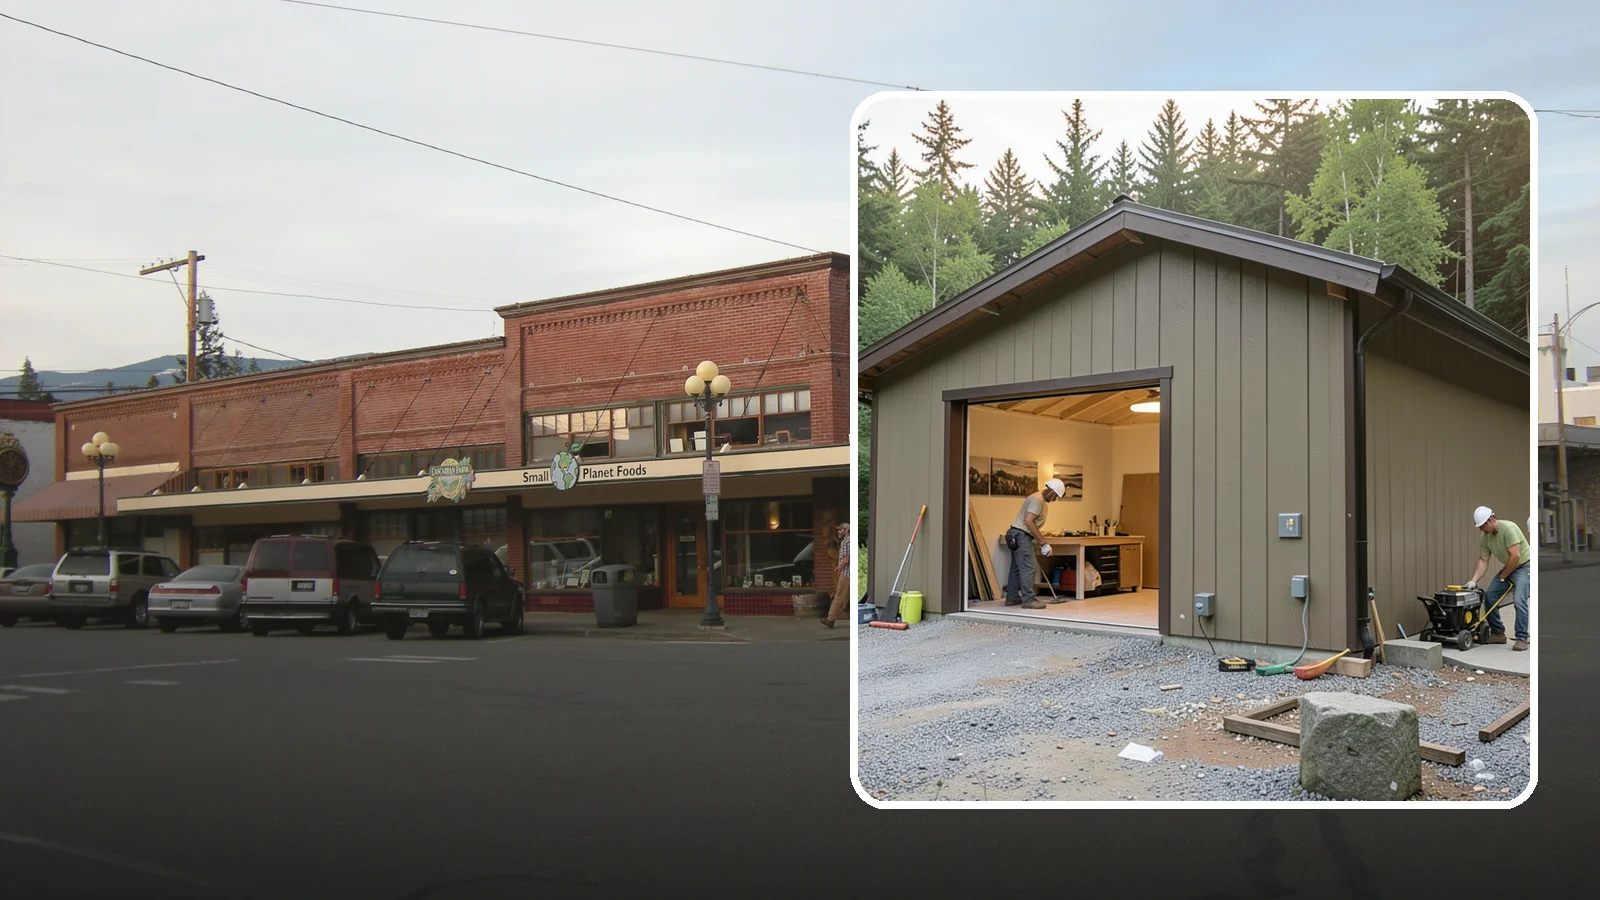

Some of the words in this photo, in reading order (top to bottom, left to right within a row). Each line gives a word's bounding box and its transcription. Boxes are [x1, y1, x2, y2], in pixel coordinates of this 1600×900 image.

[523, 470, 549, 482] Small
[583, 467, 614, 479] Planet
[617, 464, 647, 476] Foods
